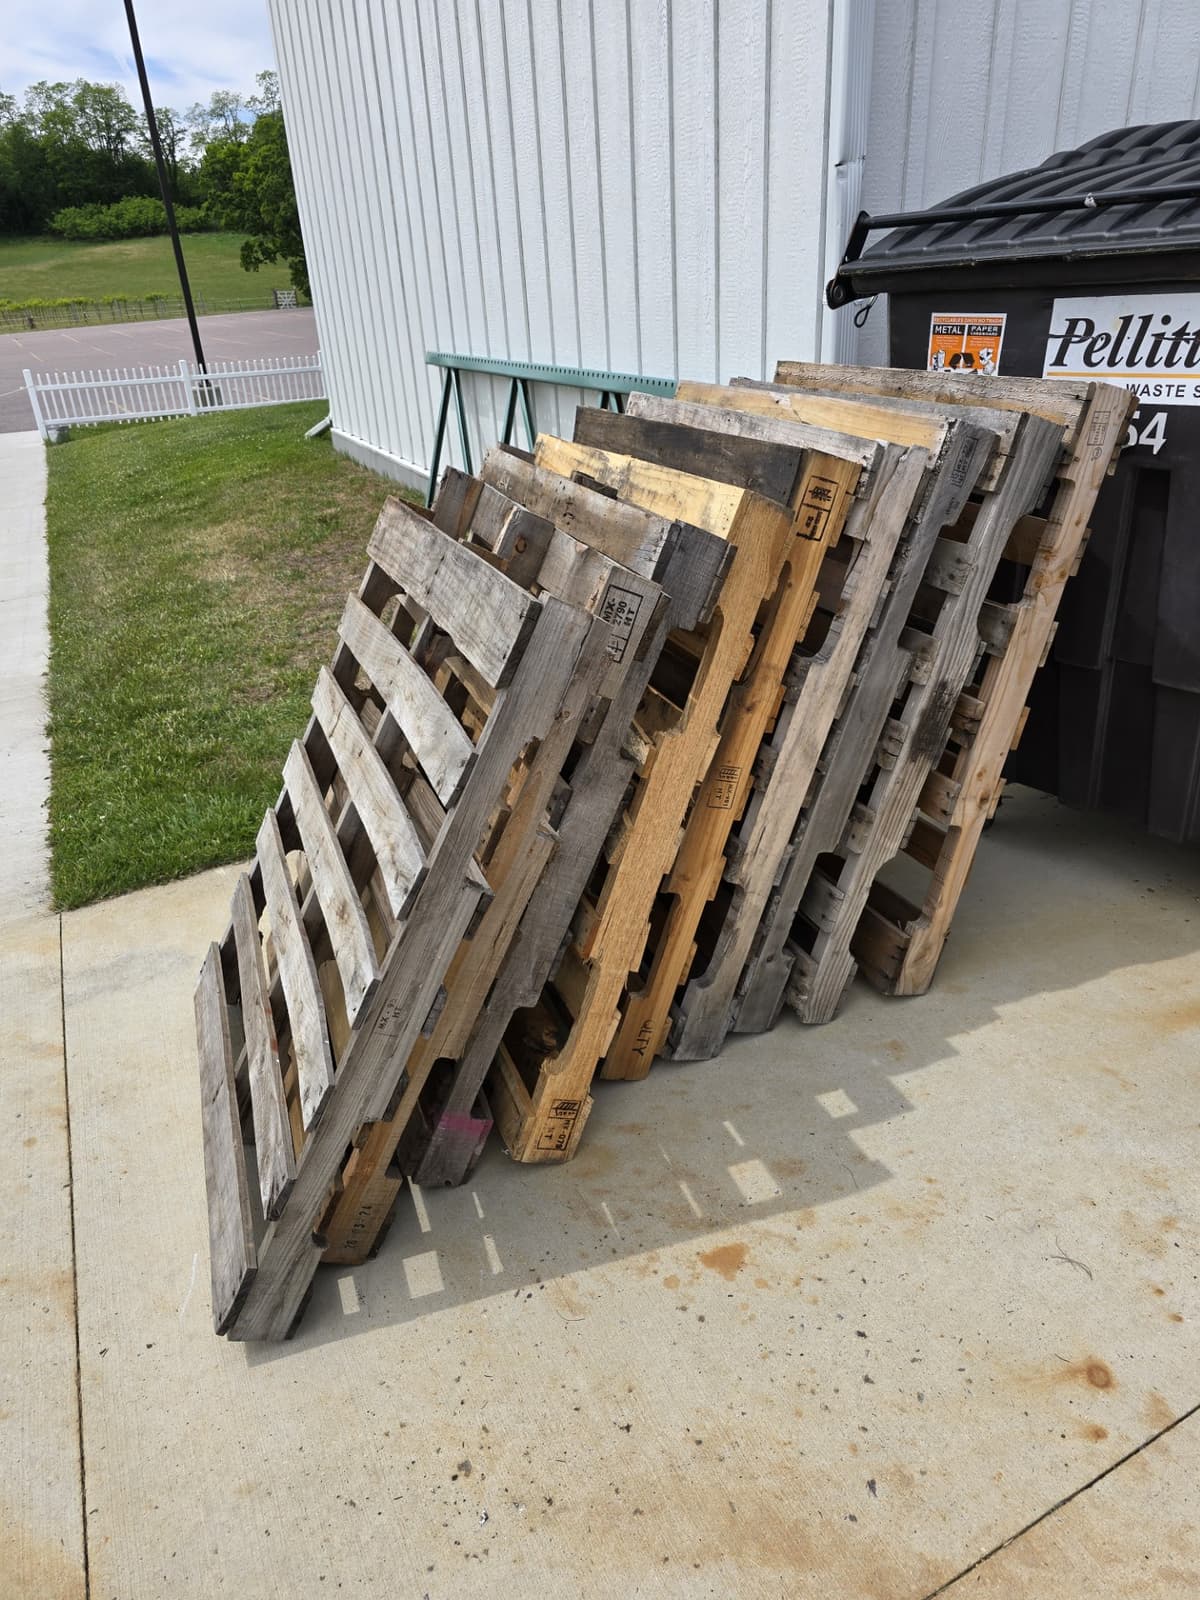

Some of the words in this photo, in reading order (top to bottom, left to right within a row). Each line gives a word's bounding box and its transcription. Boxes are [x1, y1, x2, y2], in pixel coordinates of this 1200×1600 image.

[935, 325, 963, 334] METAL
[1126, 384, 1186, 398] WASTE
[623, 608, 635, 626] HT
